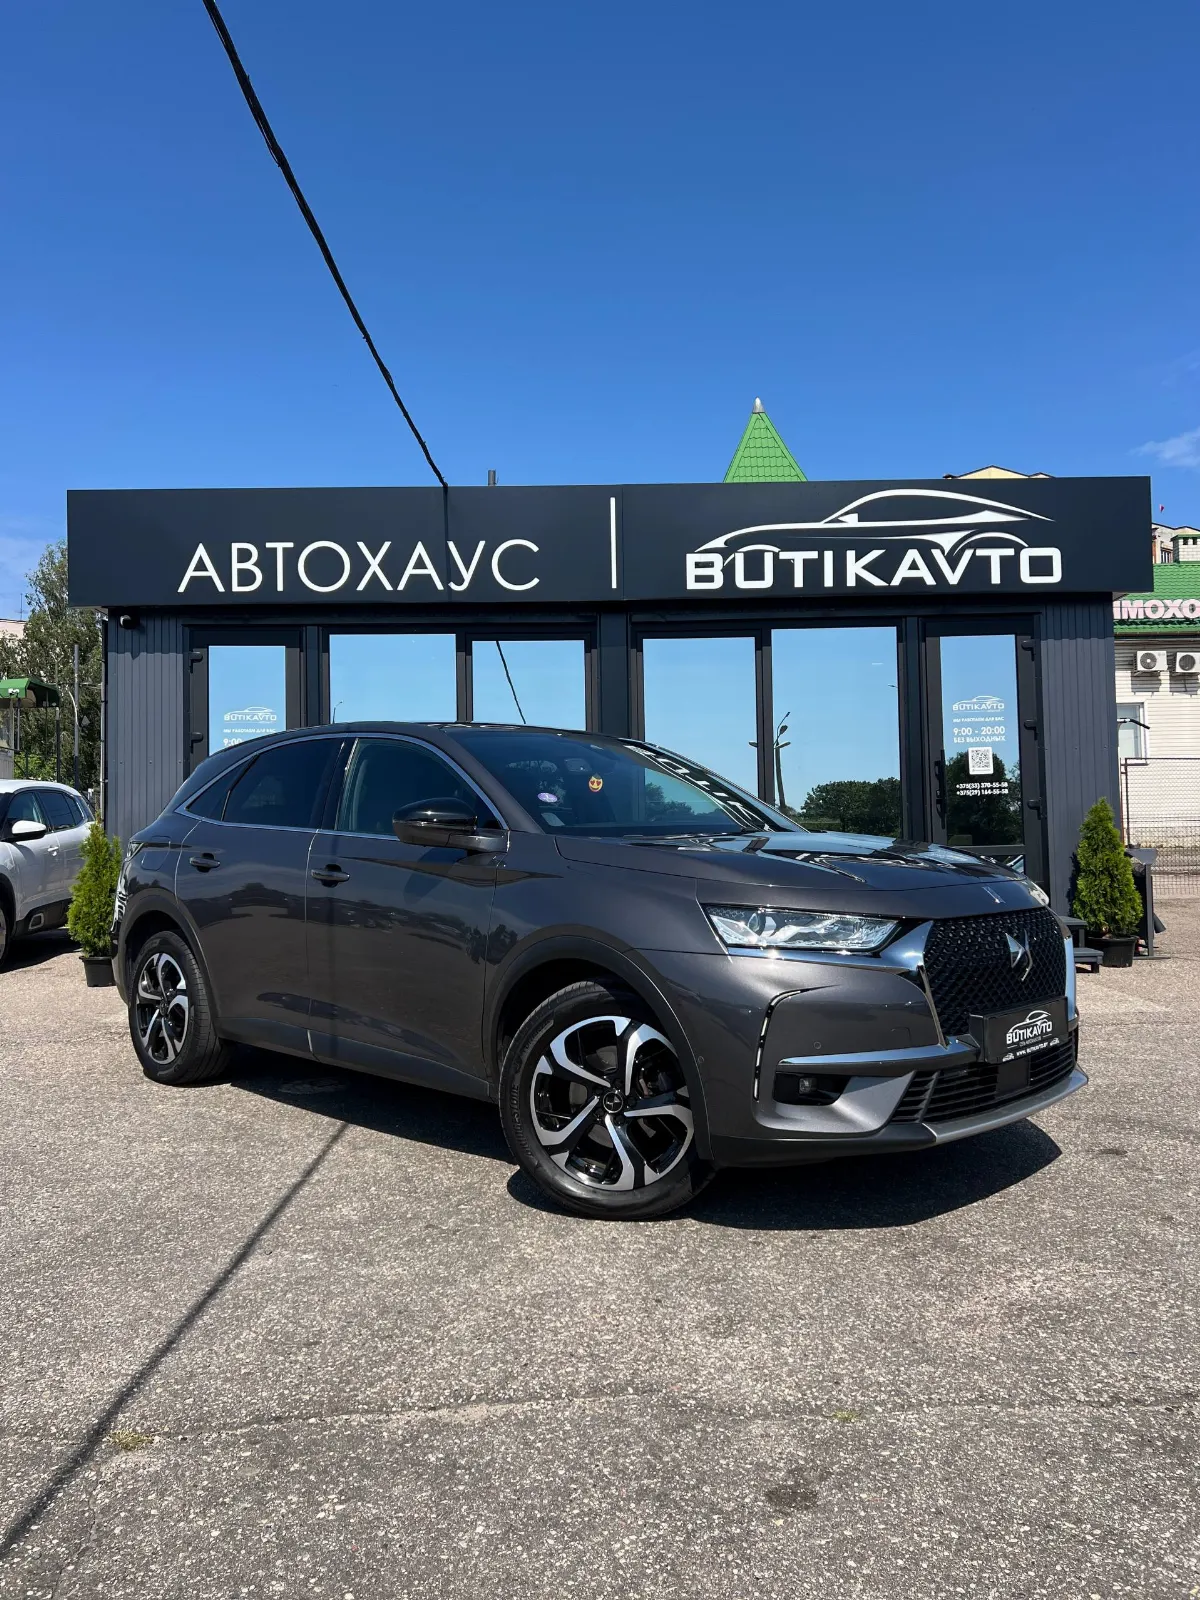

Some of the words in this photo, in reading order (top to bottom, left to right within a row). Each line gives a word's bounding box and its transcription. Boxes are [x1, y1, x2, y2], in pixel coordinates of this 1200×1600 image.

[177, 539, 541, 593] АВТОХАУС
[686, 547, 1063, 590] BUTIKAVTO
[952, 703, 1005, 711] BUTIKAVTO
[953, 727, 973, 736] 9:00
[980, 726, 1006, 735] 20:00
[966, 735, 1006, 743] ВЫХОДНЫХ
[956, 782, 980, 790] +375(33)
[1006, 1021, 1053, 1045] BUTIKAVTO
